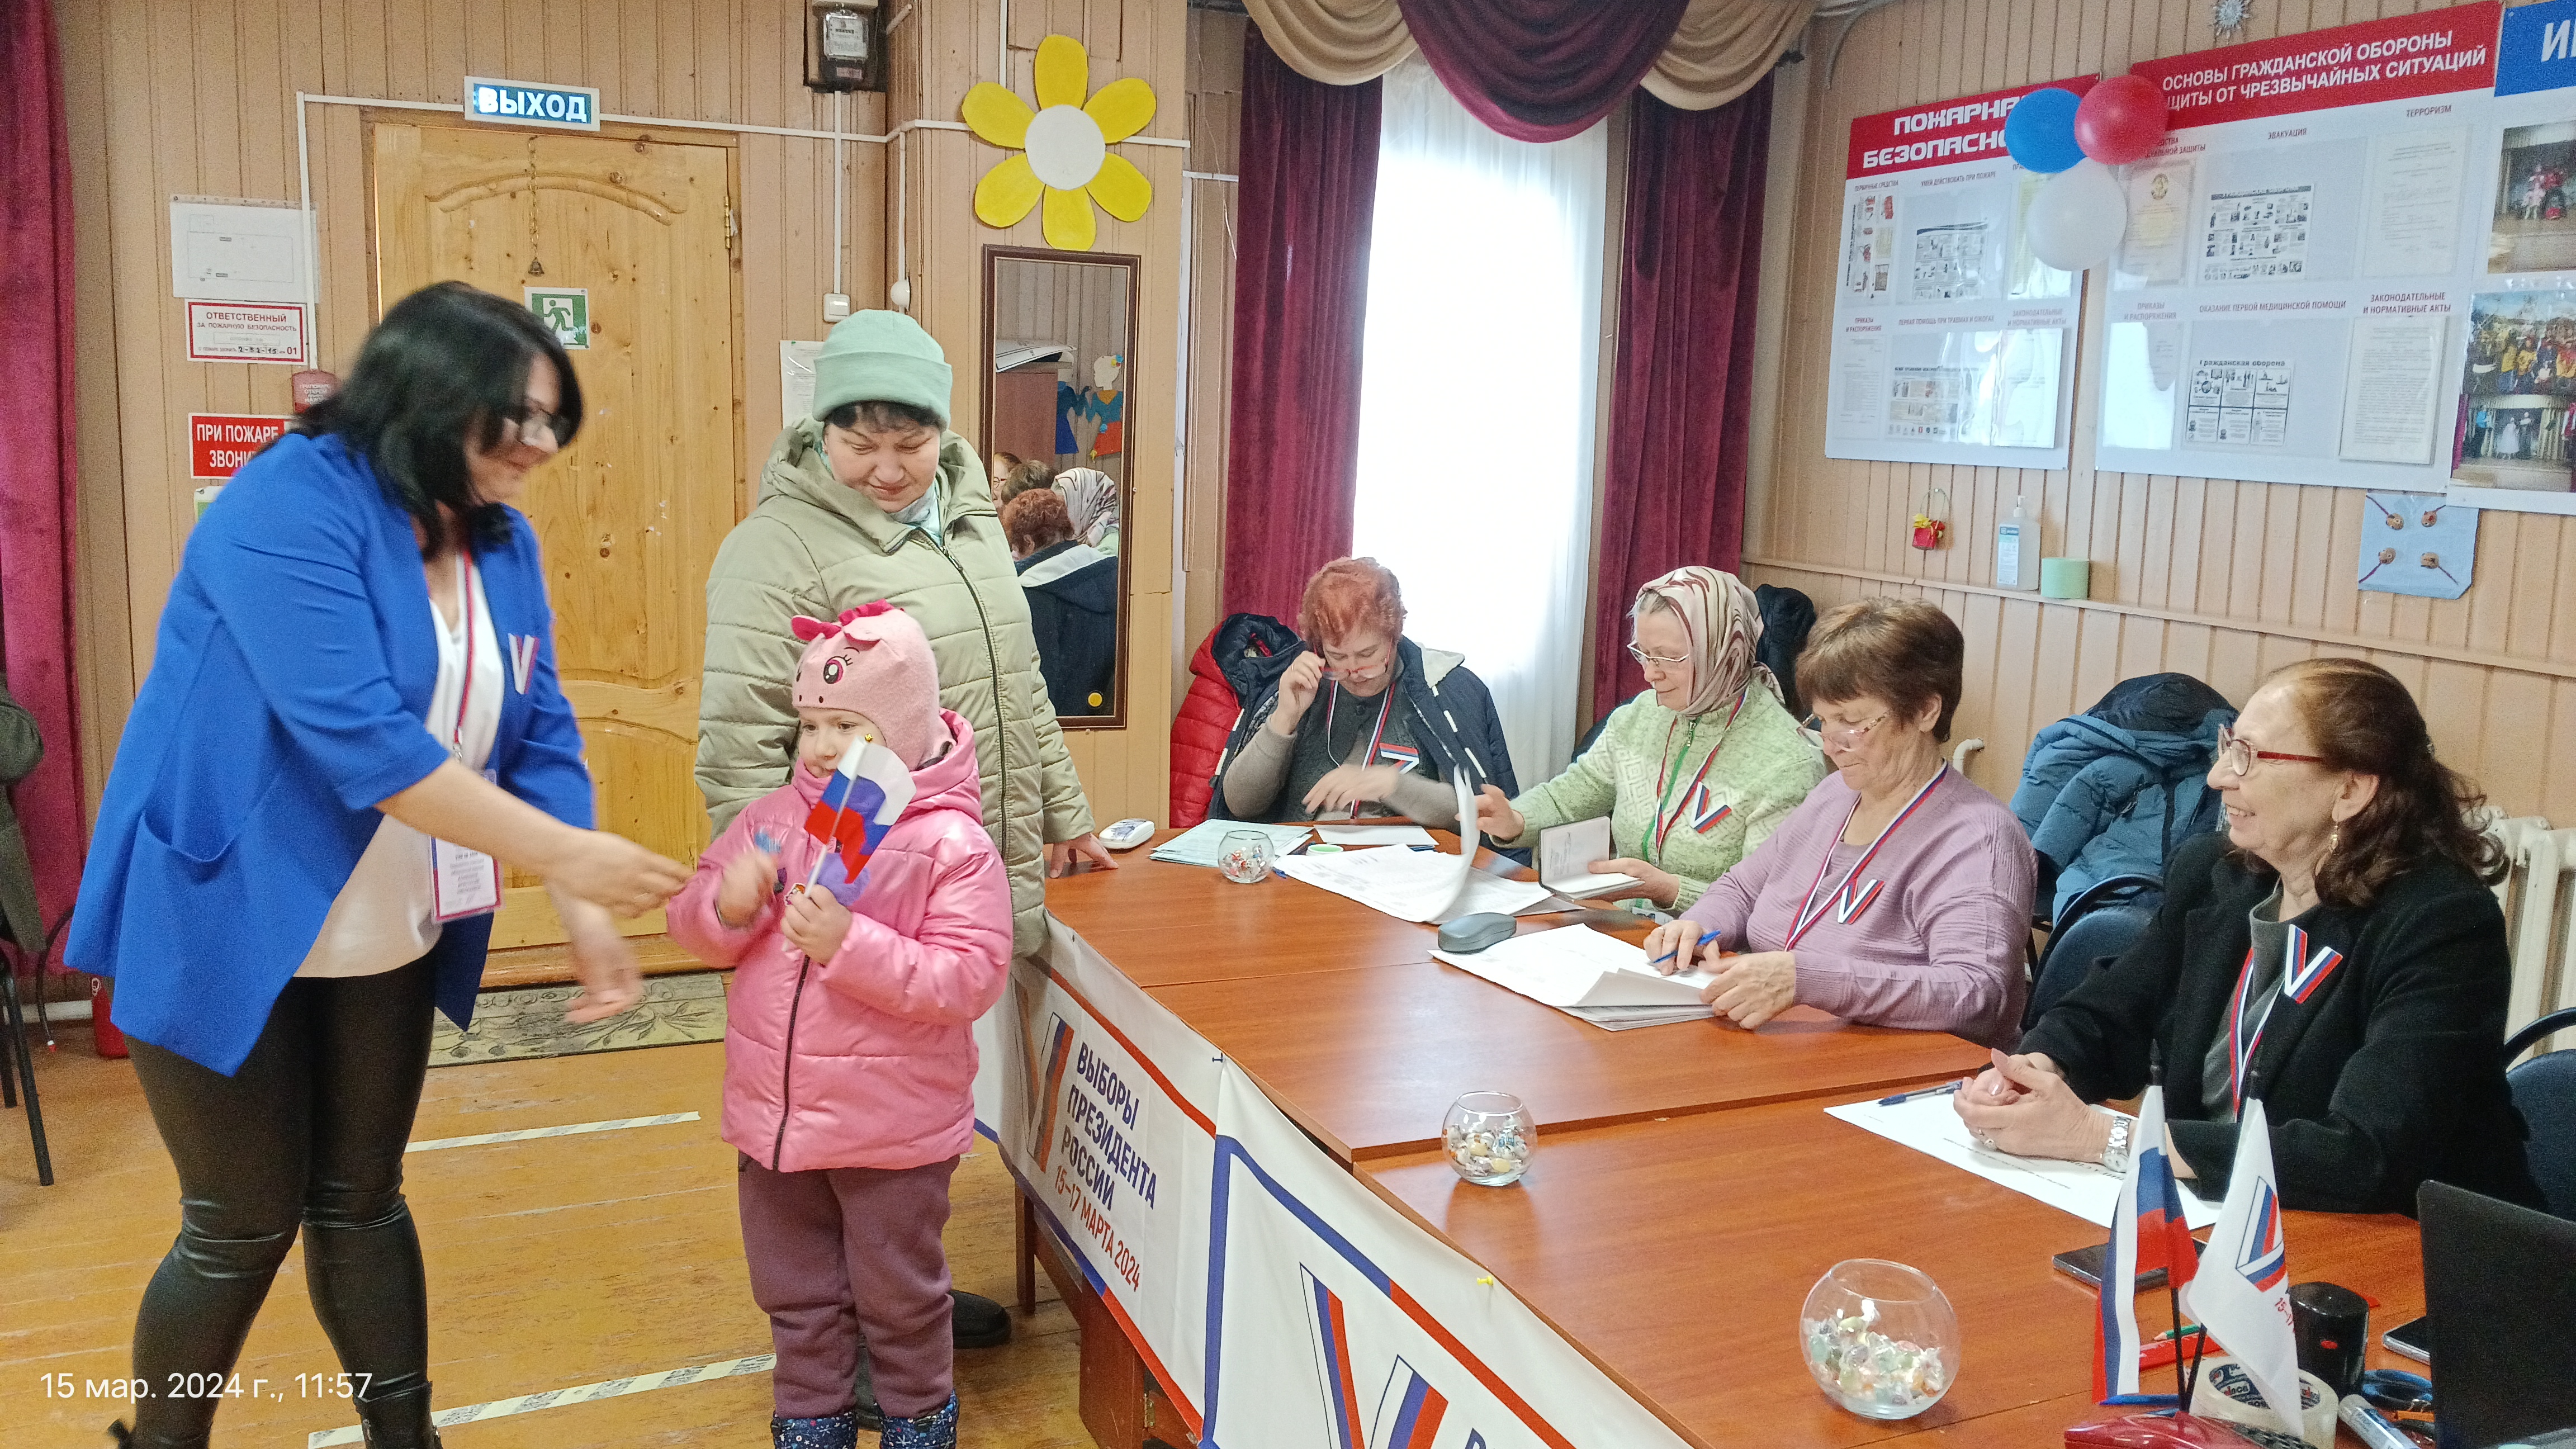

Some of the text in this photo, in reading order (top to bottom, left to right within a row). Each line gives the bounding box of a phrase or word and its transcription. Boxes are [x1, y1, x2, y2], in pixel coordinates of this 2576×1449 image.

[2541, 20, 2576, 62] И
[2163, 30, 2452, 91] ОСНОВЫ ГРАЖДАНСКОЙ ОБОРОНЫ
[2167, 45, 2487, 111] ЩИТЫ ОТ ЧРЕЗВЫЧАЙНЫХ СИТУАЦИЙ
[479, 87, 587, 123] ВЫХОД
[2407, 104, 2451, 117] ТЕРРОРИЗМ
[1894, 96, 2025, 135] ПОЖАРНА
[2268, 128, 2307, 140] ЭВАКУАЦИЯ
[2180, 143, 2205, 154] ЗАЩИТЫ
[1977, 171, 1996, 179] ПОЖАРЕ
[2371, 292, 2446, 302] ЗАКОНОДАТЕЛЬНЫЕ
[2012, 309, 2063, 317] ЗАКОНОДАТЕЛЬНЫЕ
[2137, 302, 2165, 310] ПРИКАЗЫ
[2233, 302, 2258, 312] ПЕРВОЙ
[2260, 301, 2310, 311] МЕДИЦИНСКОЙ
[2312, 300, 2346, 310] ПОМОЩИ
[2370, 305, 2427, 314] НОРМАТИВНЫЕ
[2430, 304, 2451, 312] АКТЫ
[206, 312, 286, 323] ОТВЕТСТВЕННЫЙ
[2129, 312, 2177, 321] РАСПОРЯЖЕНИЯ
[197, 424, 278, 443] ПРИ ПОЖАРЕ
[209, 450, 256, 467] ЗВОНИ
[1077, 1041, 1139, 1130] ВЫБОРЫ
[1067, 1083, 1157, 1210] ПРЕЗИДЕНТА
[1061, 1124, 1115, 1211] РОССИИ
[1081, 1196, 1114, 1258] МАРТА
[1114, 1240, 1140, 1292] 2024
